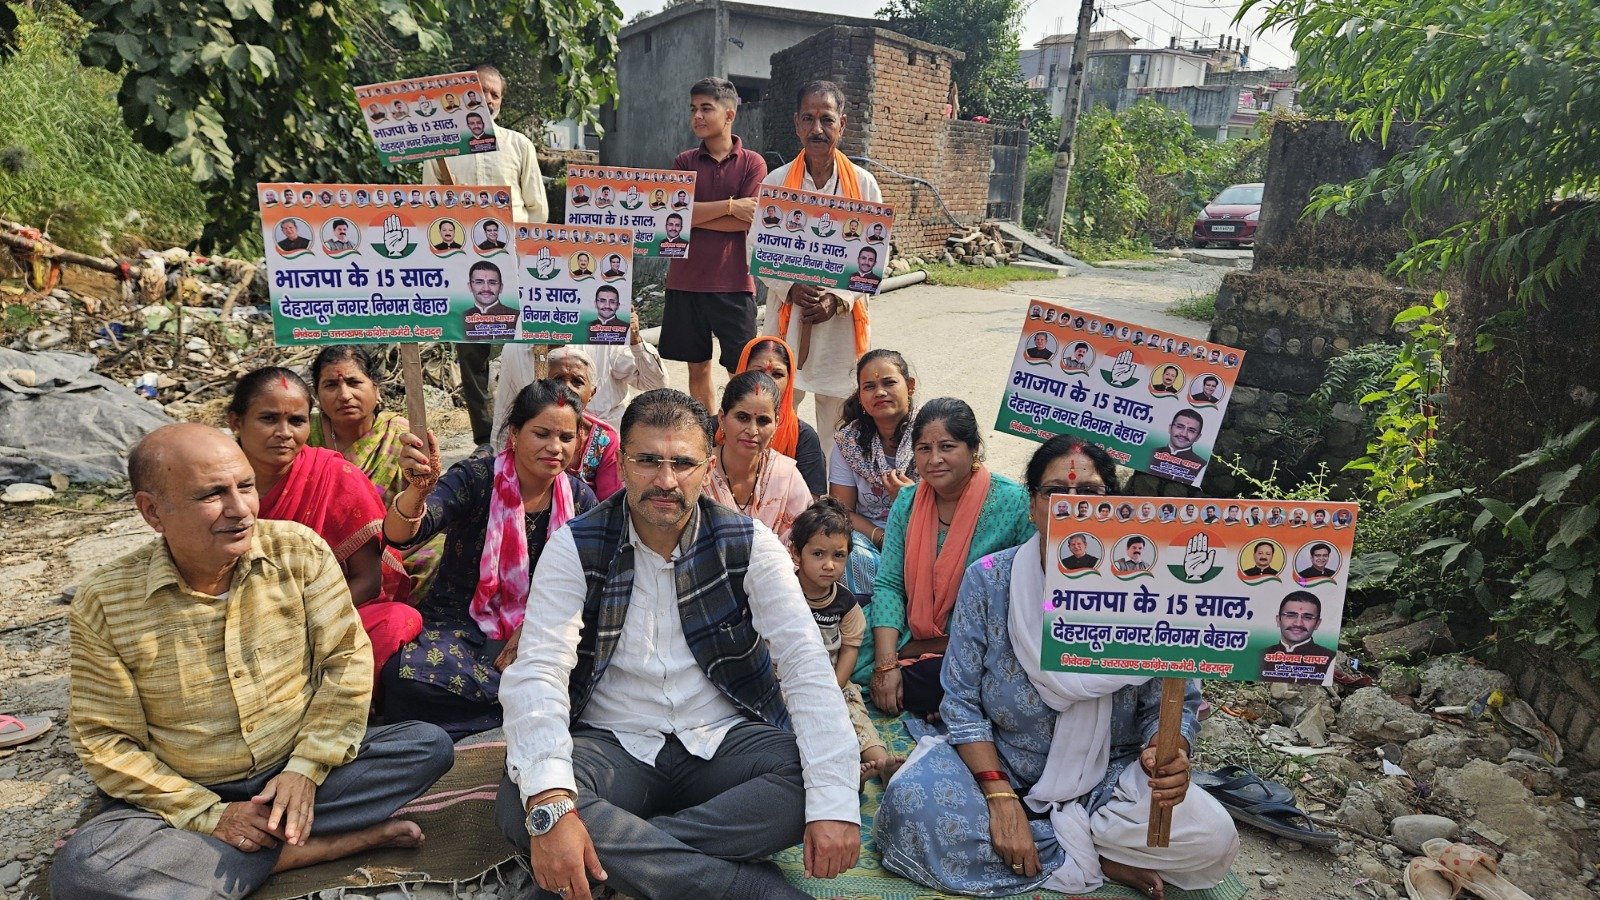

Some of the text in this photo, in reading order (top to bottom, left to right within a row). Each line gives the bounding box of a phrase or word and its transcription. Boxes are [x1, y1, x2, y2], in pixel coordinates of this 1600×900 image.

[373, 118, 458, 138] भाजपा के 15 साल,
[568, 210, 656, 227] भाजपा के 15 साल,
[758, 233, 848, 258] भाजपा के 15 साल,
[756, 250, 784, 266] देहरादून
[785, 256, 802, 266] नगर
[803, 255, 823, 269] निगम
[276, 262, 449, 288] भाजपा के 15 साल,
[281, 294, 448, 322] देहरादून नगर निगम बेहाल
[528, 288, 542, 302] 15
[546, 288, 580, 304] साल,
[523, 306, 580, 324] निगम बेहाल
[1013, 371, 1154, 424] भाजपा के 15 साल,
[1008, 392, 1146, 445] देहरादून नगर निगम बेहाल
[1052, 584, 1254, 620] भाजपा के 15 साल,
[1053, 618, 1248, 649] देहरादून नगर निगम बेहाल
[1100, 658, 1140, 669] उत्तराखण्ड
[1142, 658, 1168, 672] कांग्रेस
[1199, 661, 1232, 676] देहरादून
